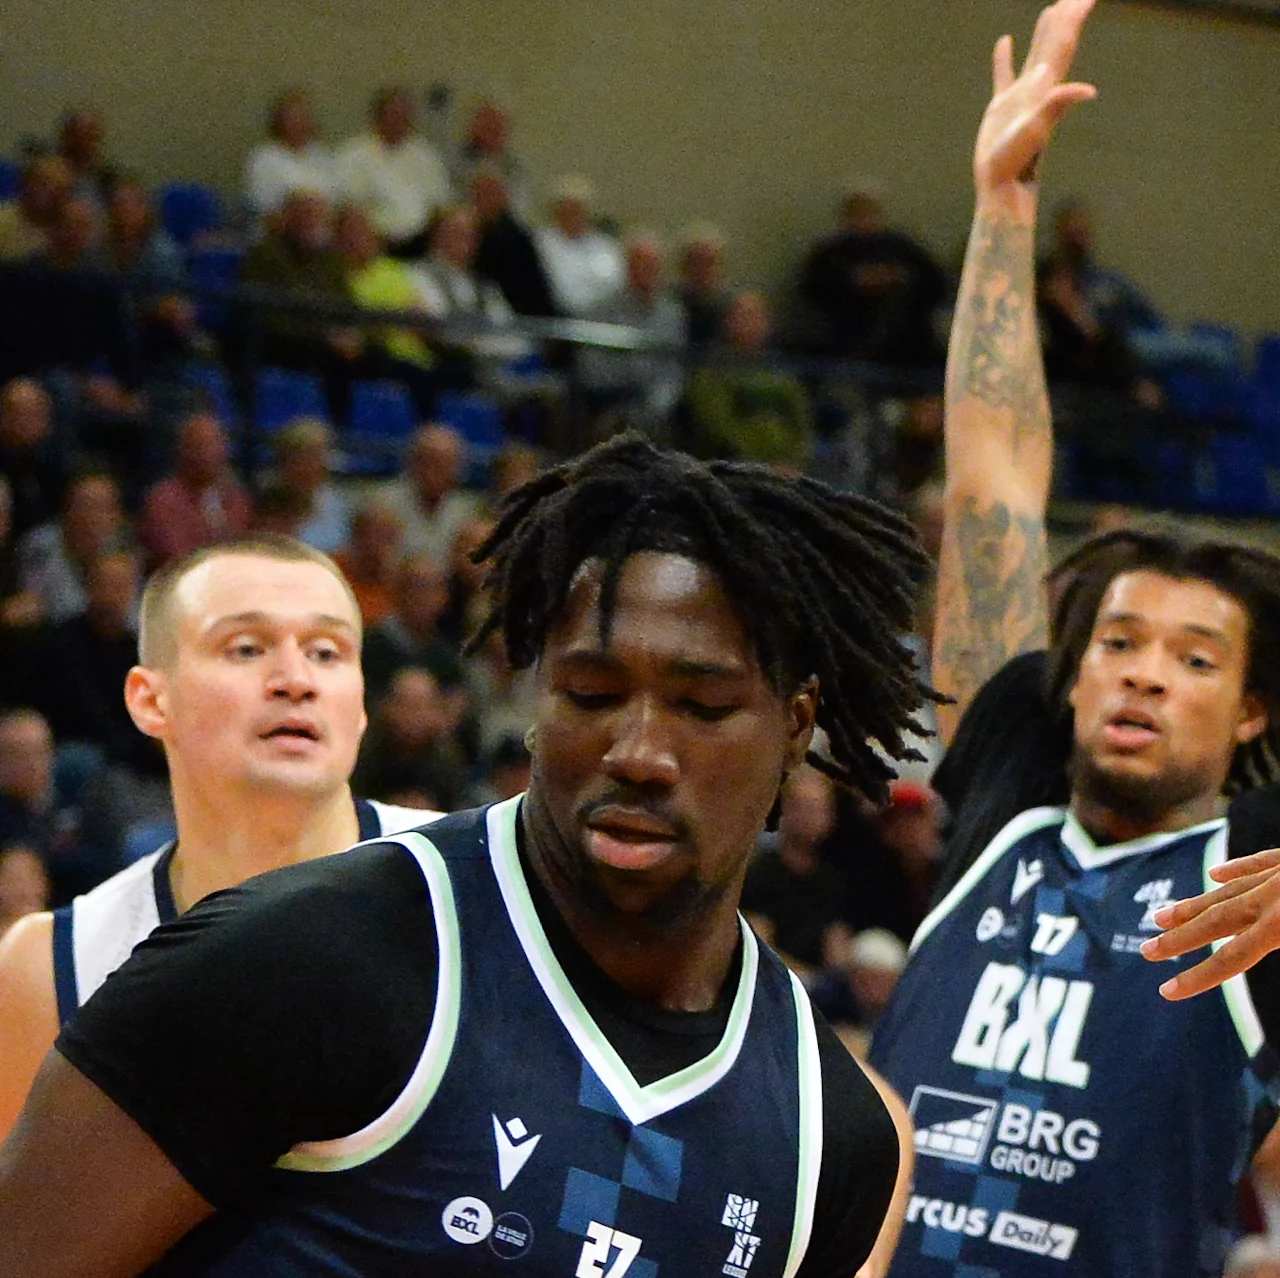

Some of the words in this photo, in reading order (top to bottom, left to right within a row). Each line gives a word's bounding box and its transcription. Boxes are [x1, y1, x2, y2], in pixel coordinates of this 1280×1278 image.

[1031, 913, 1079, 956] 17
[951, 961, 1094, 1090] BXL
[997, 1102, 1100, 1161] BRG
[990, 1144, 1076, 1184] GROUP
[450, 1214, 480, 1236] BXL
[905, 1195, 989, 1237] rcus
[1002, 1219, 1065, 1251] Daily
